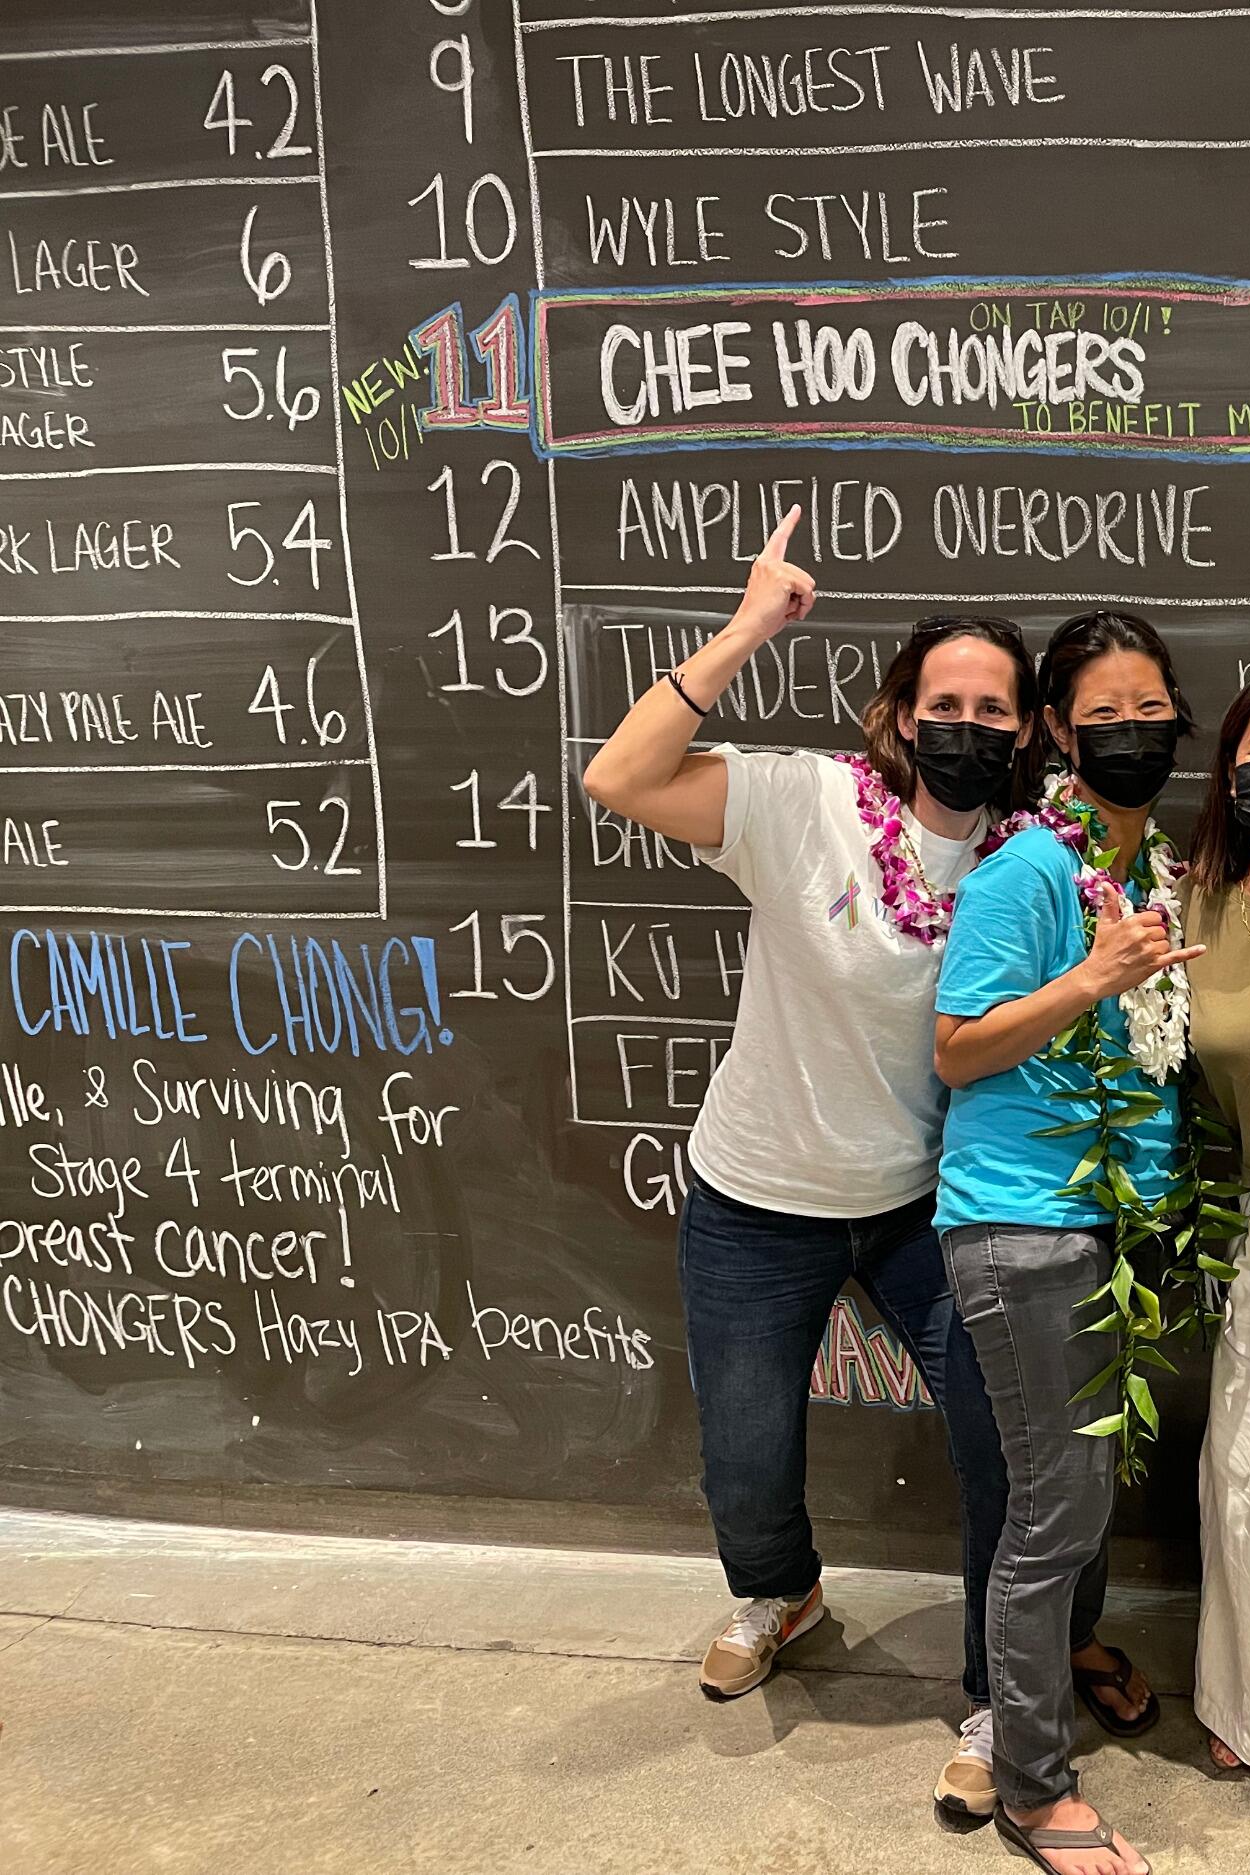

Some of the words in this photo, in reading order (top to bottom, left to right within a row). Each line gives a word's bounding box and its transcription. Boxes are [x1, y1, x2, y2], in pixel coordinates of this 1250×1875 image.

[204, 64, 312, 158] 4.2
[430, 33, 474, 143] 9
[556, 54, 674, 127] THE
[694, 46, 892, 121] LONGEST
[916, 40, 1066, 114] WAVE
[0, 105, 28, 170] E
[43, 103, 115, 166] ALE
[9, 231, 150, 296] LAGER
[240, 205, 291, 305] 6
[408, 173, 516, 268] 10
[584, 193, 732, 267] WYLE
[764, 187, 960, 264] STYLE
[969, 302, 1012, 332] ON
[1033, 301, 1086, 330] TAP
[221, 346, 320, 431] 5.6
[408, 293, 530, 433] 11
[601, 320, 752, 426] CHEE
[772, 319, 876, 408] HOO
[890, 320, 1146, 410] CHONGERS
[0, 411, 96, 449] AGER
[1012, 401, 1051, 432] TO
[1069, 400, 1201, 438] BENEFIT
[46, 519, 181, 573] LAGER
[226, 500, 332, 590] 5.4
[427, 459, 541, 564] 12
[933, 483, 1216, 569] OVERDRIVE
[427, 605, 548, 697] 13
[60, 691, 139, 745] PALE
[153, 691, 213, 748] ALE
[247, 657, 347, 746] 4.6
[3, 819, 70, 867] ALE
[266, 797, 363, 875] 5.2
[450, 769, 553, 850] 14
[10, 928, 208, 1044] CAMILLE
[229, 932, 454, 1057] CHONG!
[448, 910, 556, 1001] 15
[82, 1065, 109, 1108] &
[132, 1058, 350, 1159] Surviving
[378, 1071, 461, 1155] for
[29, 1142, 150, 1219] Stage
[165, 1136, 201, 1208] 4
[220, 1138, 401, 1213] terminal
[3, 1273, 237, 1370] CHONGERS
[254, 1288, 363, 1377] Hazy
[378, 1308, 453, 1367] IPA
[466, 1279, 656, 1371] benefits
